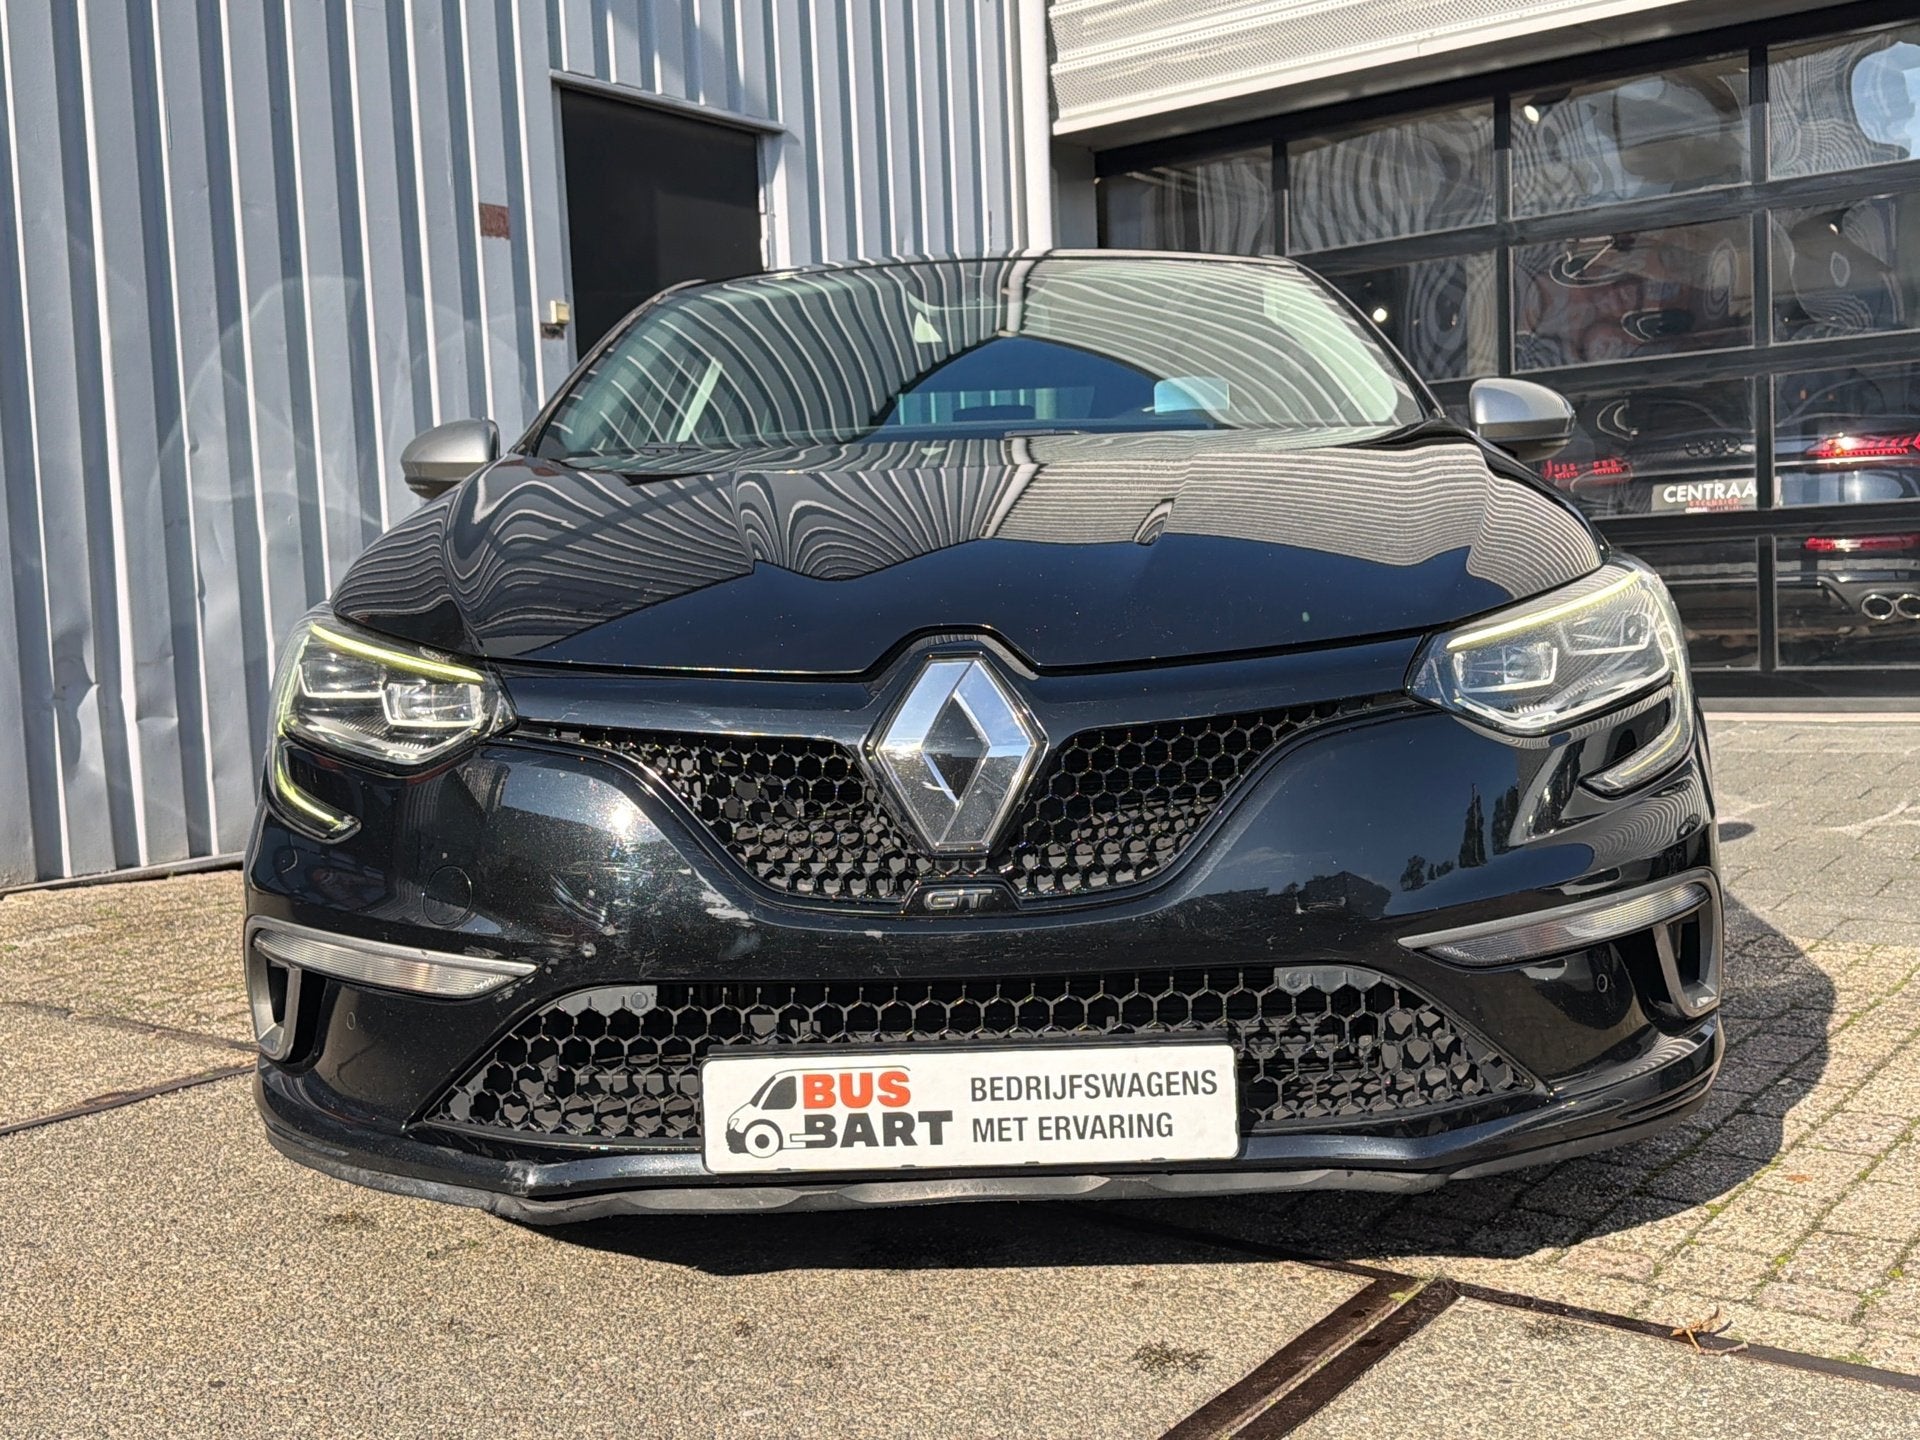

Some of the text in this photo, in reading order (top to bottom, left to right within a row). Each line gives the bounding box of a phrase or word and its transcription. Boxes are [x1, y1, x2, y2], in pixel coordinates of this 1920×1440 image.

[1663, 481, 1758, 503] CENTRAA
[925, 888, 993, 910] GT
[803, 1071, 911, 1108] BUS
[971, 1070, 1217, 1102] BEDRIJFSWAGENS
[804, 1110, 953, 1148] BART
[972, 1112, 1174, 1143] MET ERVARING
